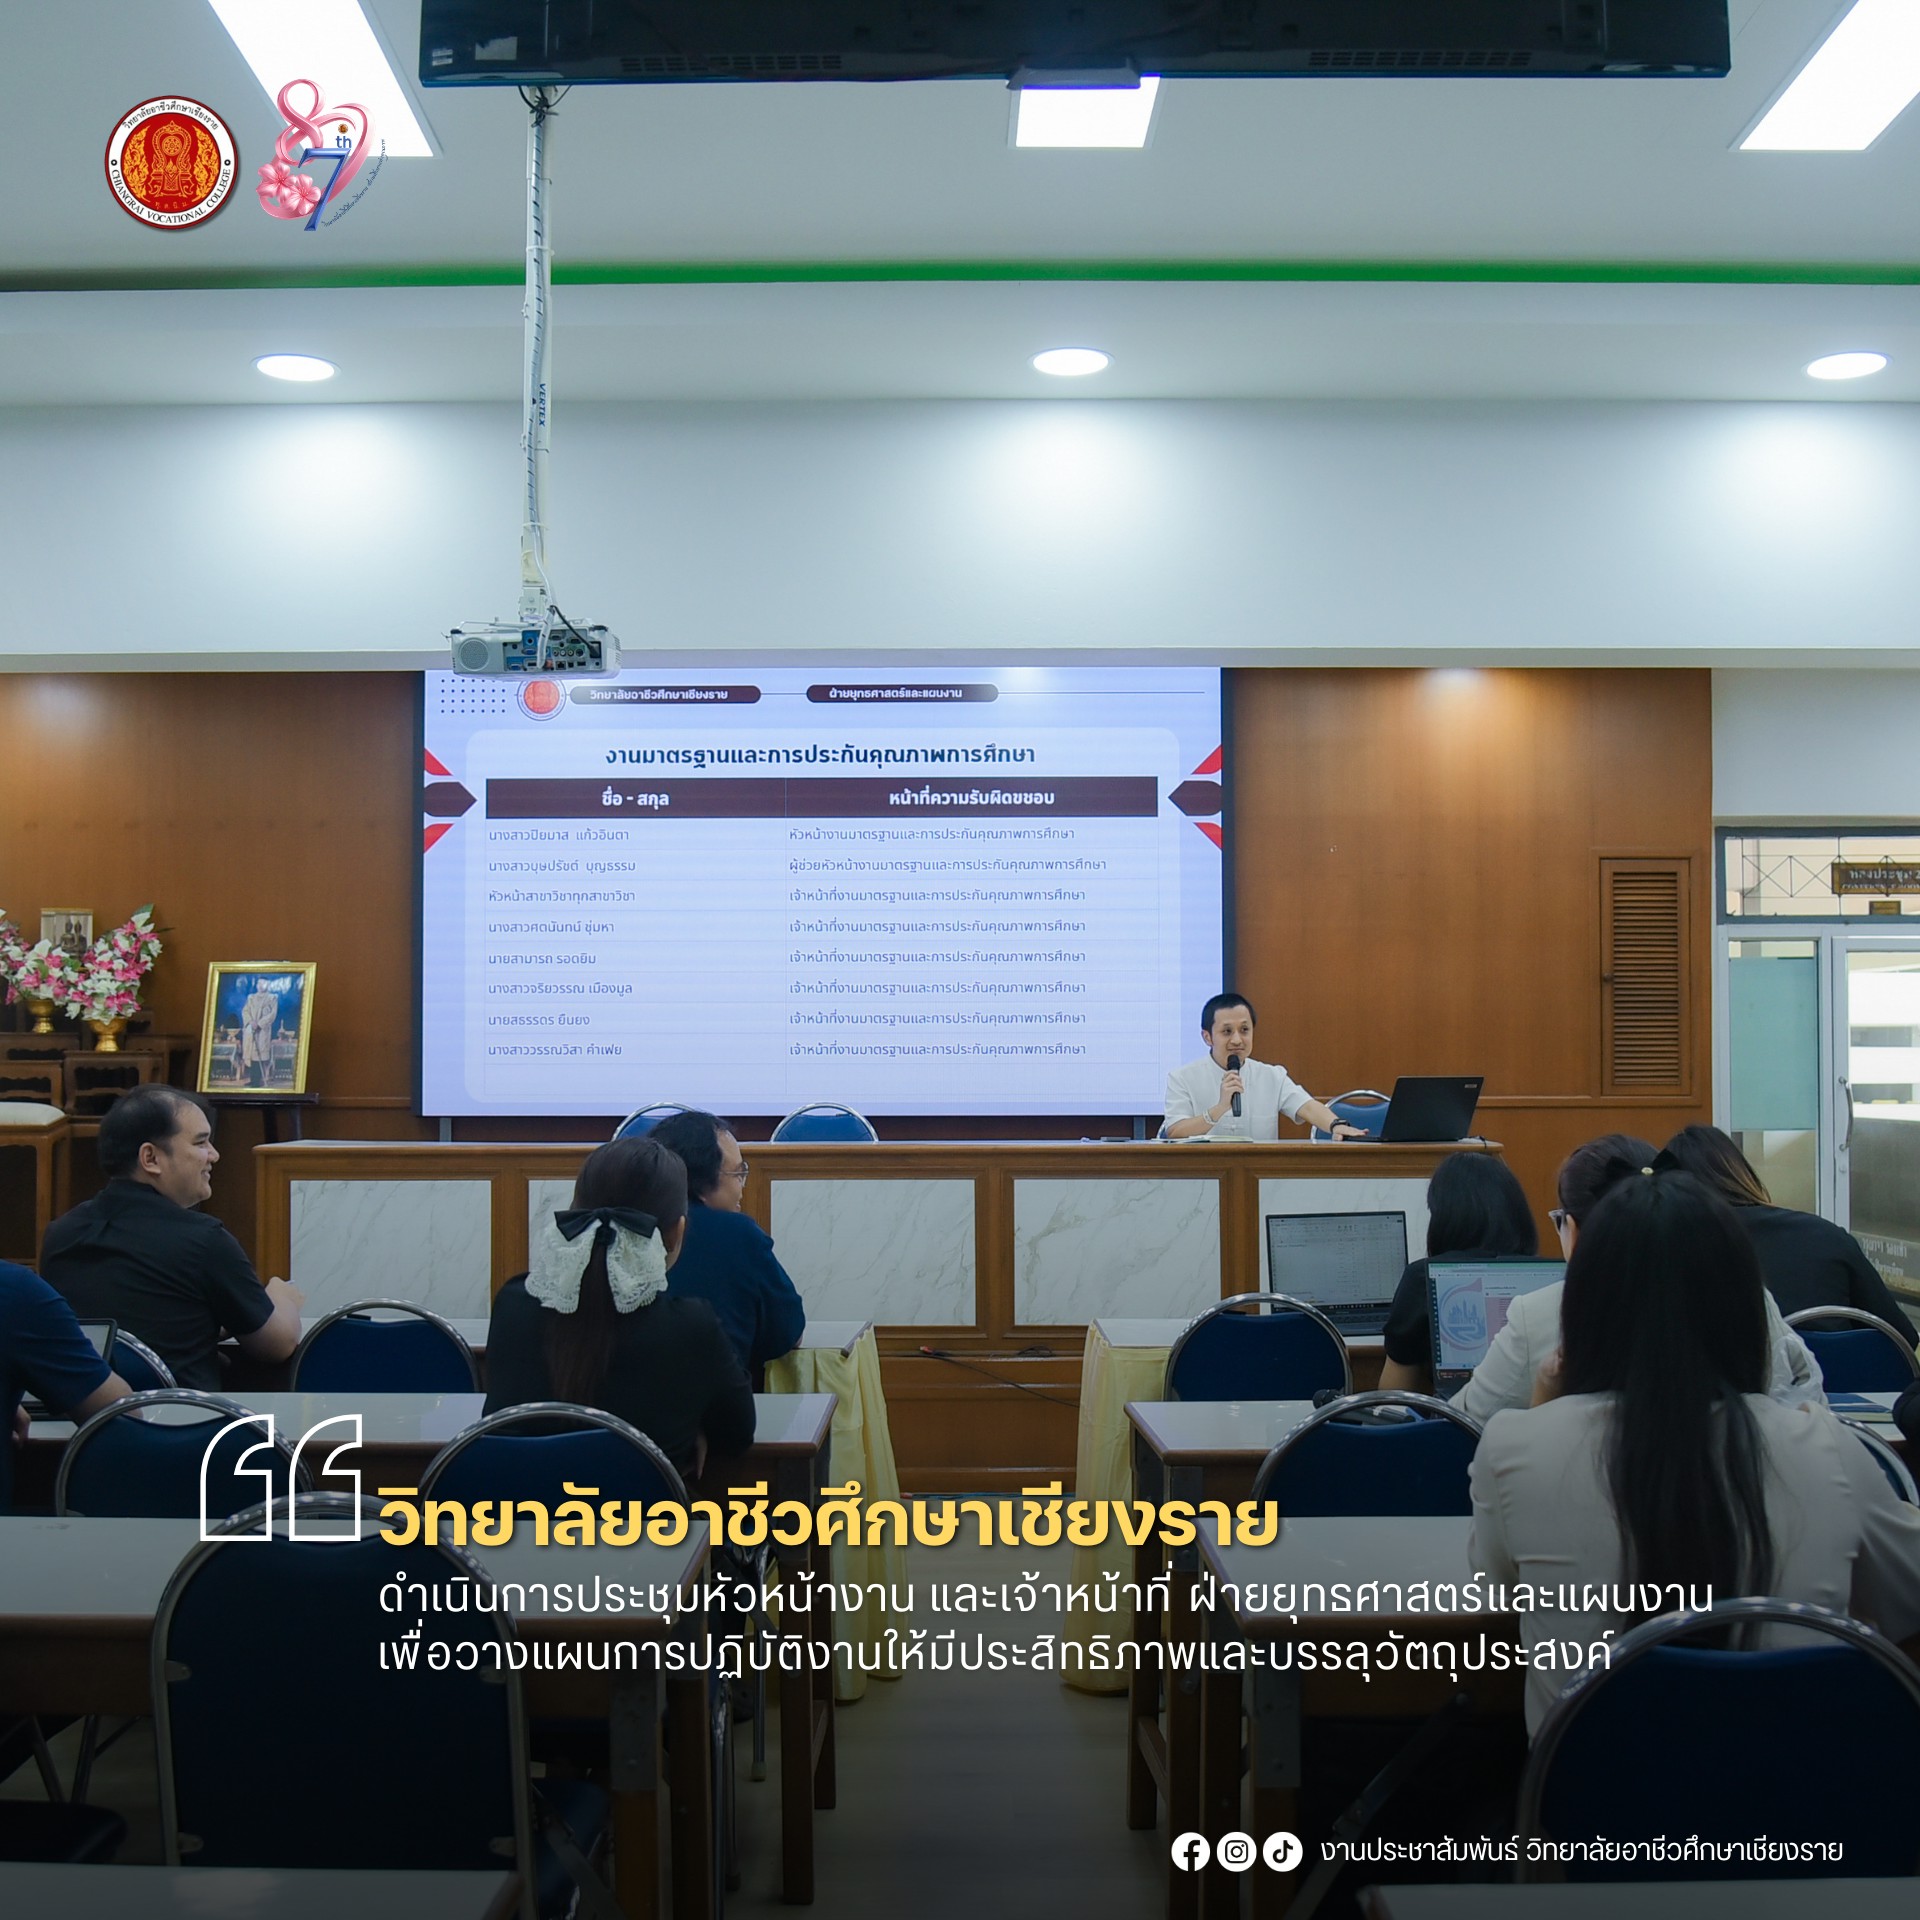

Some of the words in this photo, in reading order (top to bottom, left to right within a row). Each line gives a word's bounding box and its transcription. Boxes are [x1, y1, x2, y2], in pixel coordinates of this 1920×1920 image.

[538, 383, 546, 427] VERTEX
[589, 687, 729, 701] วิทยาลัยอาชีวศึกษาเชียงราย
[829, 687, 963, 701] ฝ่ายยุทธศาสตร์และแผนงาน
[605, 742, 1035, 770] งานมาตรฐานและการประกันคุณภาพการศึกษา
[601, 785, 623, 807] ชื่อ
[636, 793, 670, 811] สกุล
[789, 826, 1075, 843] หัวหน้างานมาตรฐานและการประกันคุณภาพการศึกษา
[585, 861, 636, 875] บุญธรรม
[789, 857, 1107, 875] ผู้ช่วยหัวหน้างานมาตรฐานและการประกันคุณภาพการศึกษา
[1849, 867, 1913, 882] หองประชุม
[488, 888, 636, 905] หัวหน้าสาขาวิชาทุกสาขาวิชา
[789, 885, 1086, 904] เจ้าหน้าที่งานมาตรฐานและการประกันคุณภาพการศึกษา
[789, 916, 1086, 936] เจ้าหน้าที่งานมาตรฐานและการประกันคุณภาพการศึกษา
[488, 954, 553, 965] นายสามารถ
[789, 947, 1086, 966] เจ้าหน้าที่งานมาตรฐานและการประกันคุณภาพการศึกษา
[789, 978, 1086, 997] เจ้าหน้าที่งานมาตรฐานและการประกันคุณภาพการศึกษา
[789, 1008, 1086, 1027] เจ้าหน้าที่งานมาตรฐานและการประกันคุณภาพการศึกษา
[789, 1039, 1086, 1058] เจ้าหน้าที่งานมาตรฐานและการประกันคุณภาพการศึกษา
